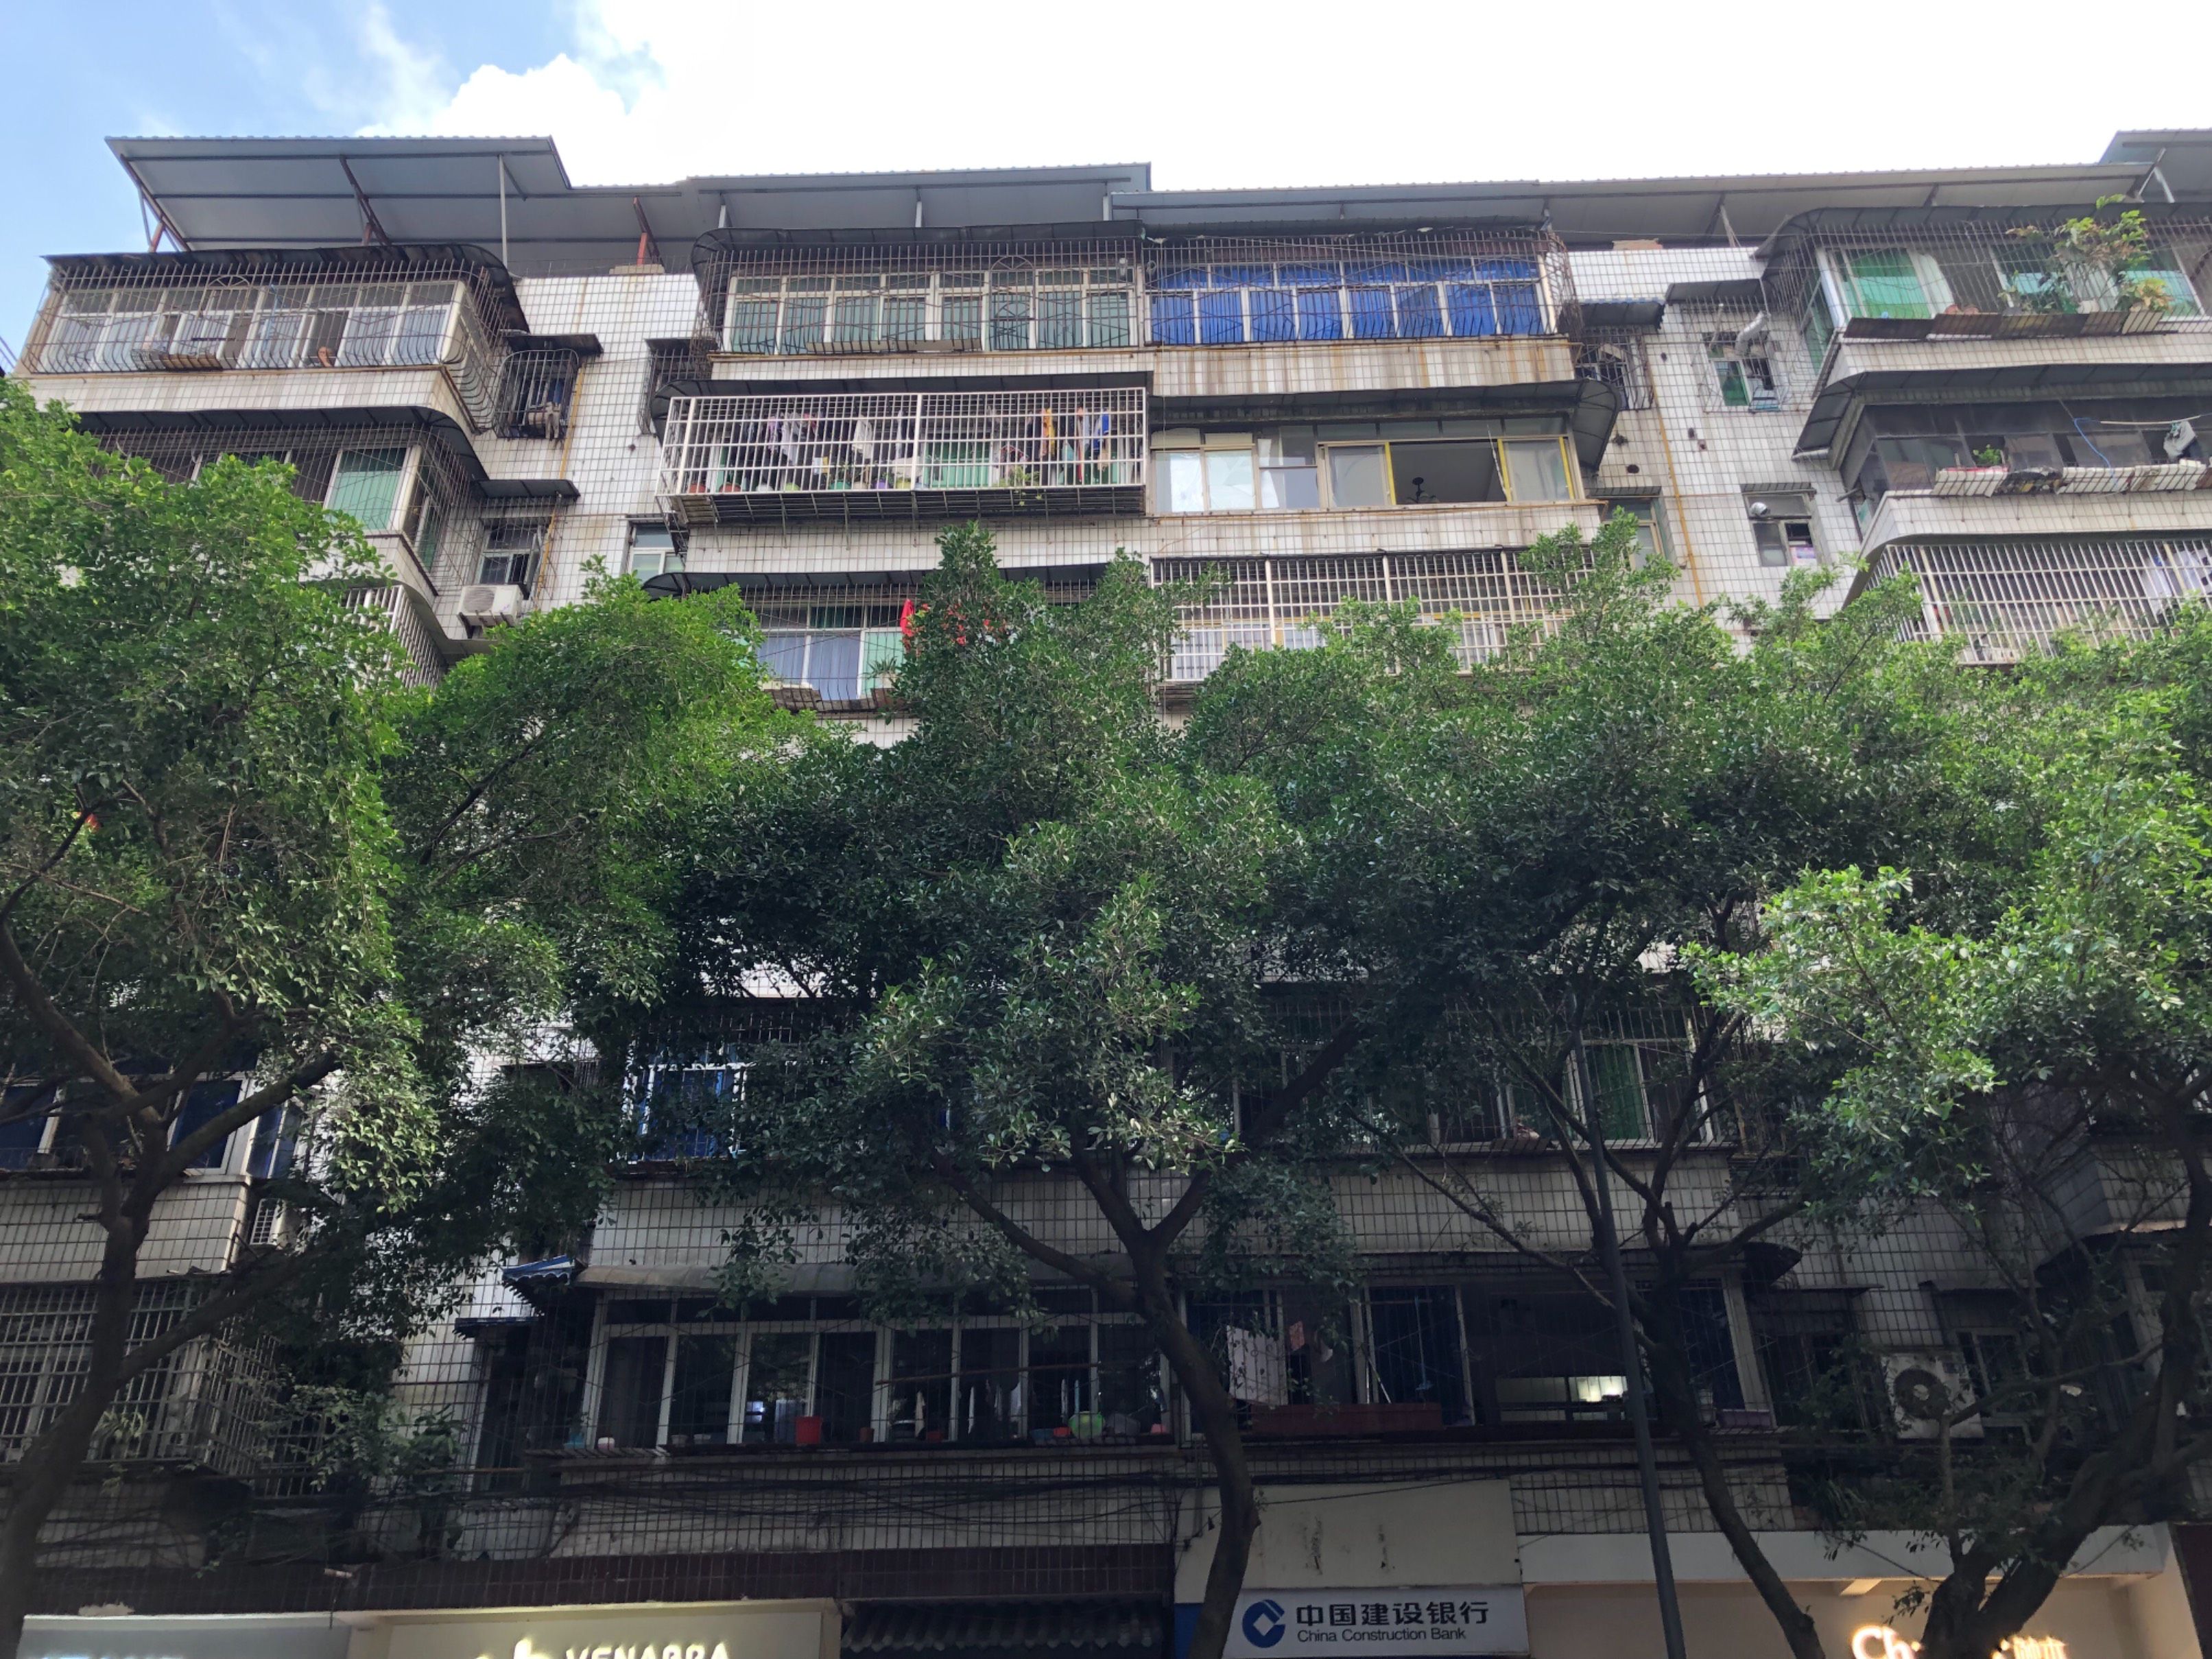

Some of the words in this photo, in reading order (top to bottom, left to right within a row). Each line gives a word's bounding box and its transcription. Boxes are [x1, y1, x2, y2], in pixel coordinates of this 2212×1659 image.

[1296, 1601, 1489, 1626] 中国建设银行
[1297, 1629, 1337, 1643] China
[1342, 1627, 1427, 1642] Construction
[1431, 1626, 1466, 1640] Bank
